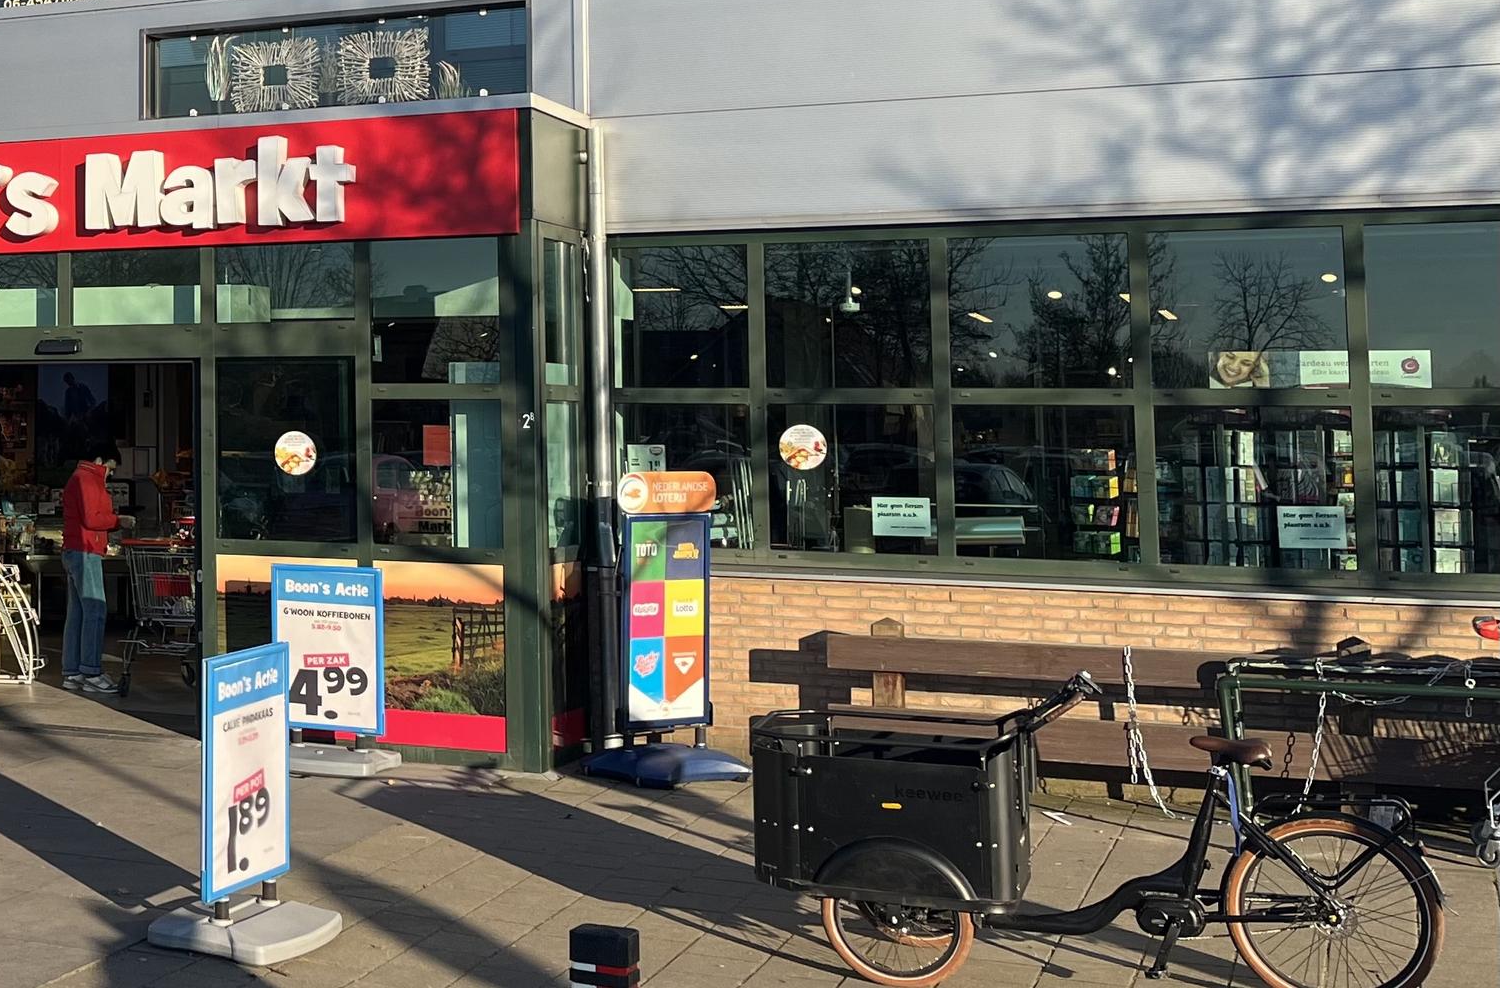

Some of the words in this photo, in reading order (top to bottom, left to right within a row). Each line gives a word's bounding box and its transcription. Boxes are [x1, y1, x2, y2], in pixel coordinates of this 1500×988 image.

[85, 135, 357, 230] Markt
[652, 481, 708, 492] NEDERLANDSE
[652, 492, 687, 503] LOTERIJ
[415, 505, 452, 517] Boon'
[635, 543, 658, 557] TOTO
[285, 578, 331, 595] Boon's
[335, 582, 369, 597] Actie
[316, 610, 371, 621] KOFFIEBONEN
[306, 656, 326, 665] PER
[327, 655, 346, 665] ZAK
[217, 675, 252, 703] Boon's
[254, 667, 278, 691] Actie
